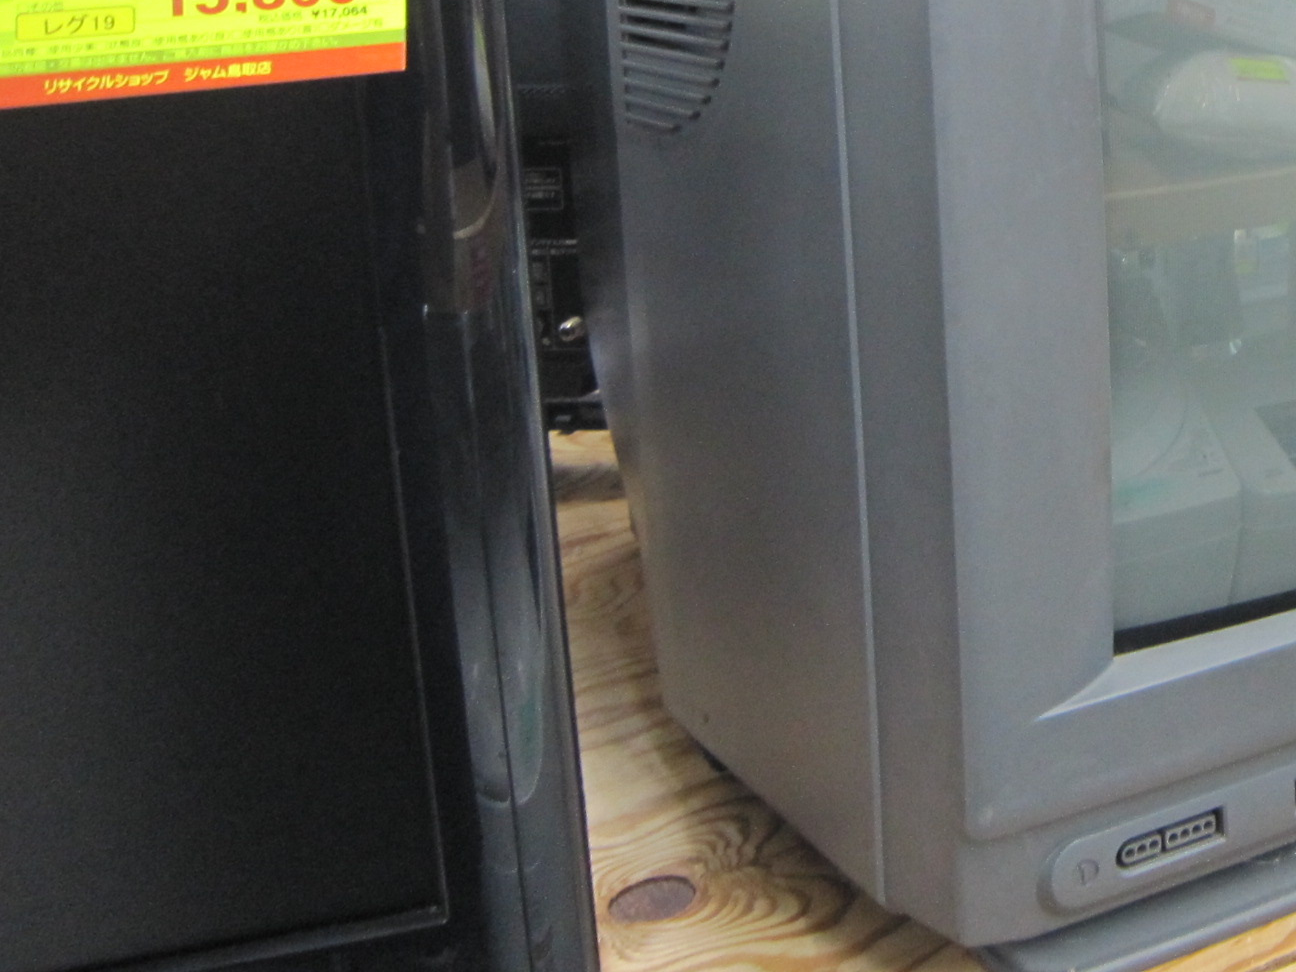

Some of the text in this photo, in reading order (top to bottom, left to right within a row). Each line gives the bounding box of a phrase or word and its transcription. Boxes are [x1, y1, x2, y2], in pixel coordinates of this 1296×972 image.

[44, 14, 116, 35] レグ19
[44, 61, 272, 95] リサイクルショップ ジャム鳥取店
